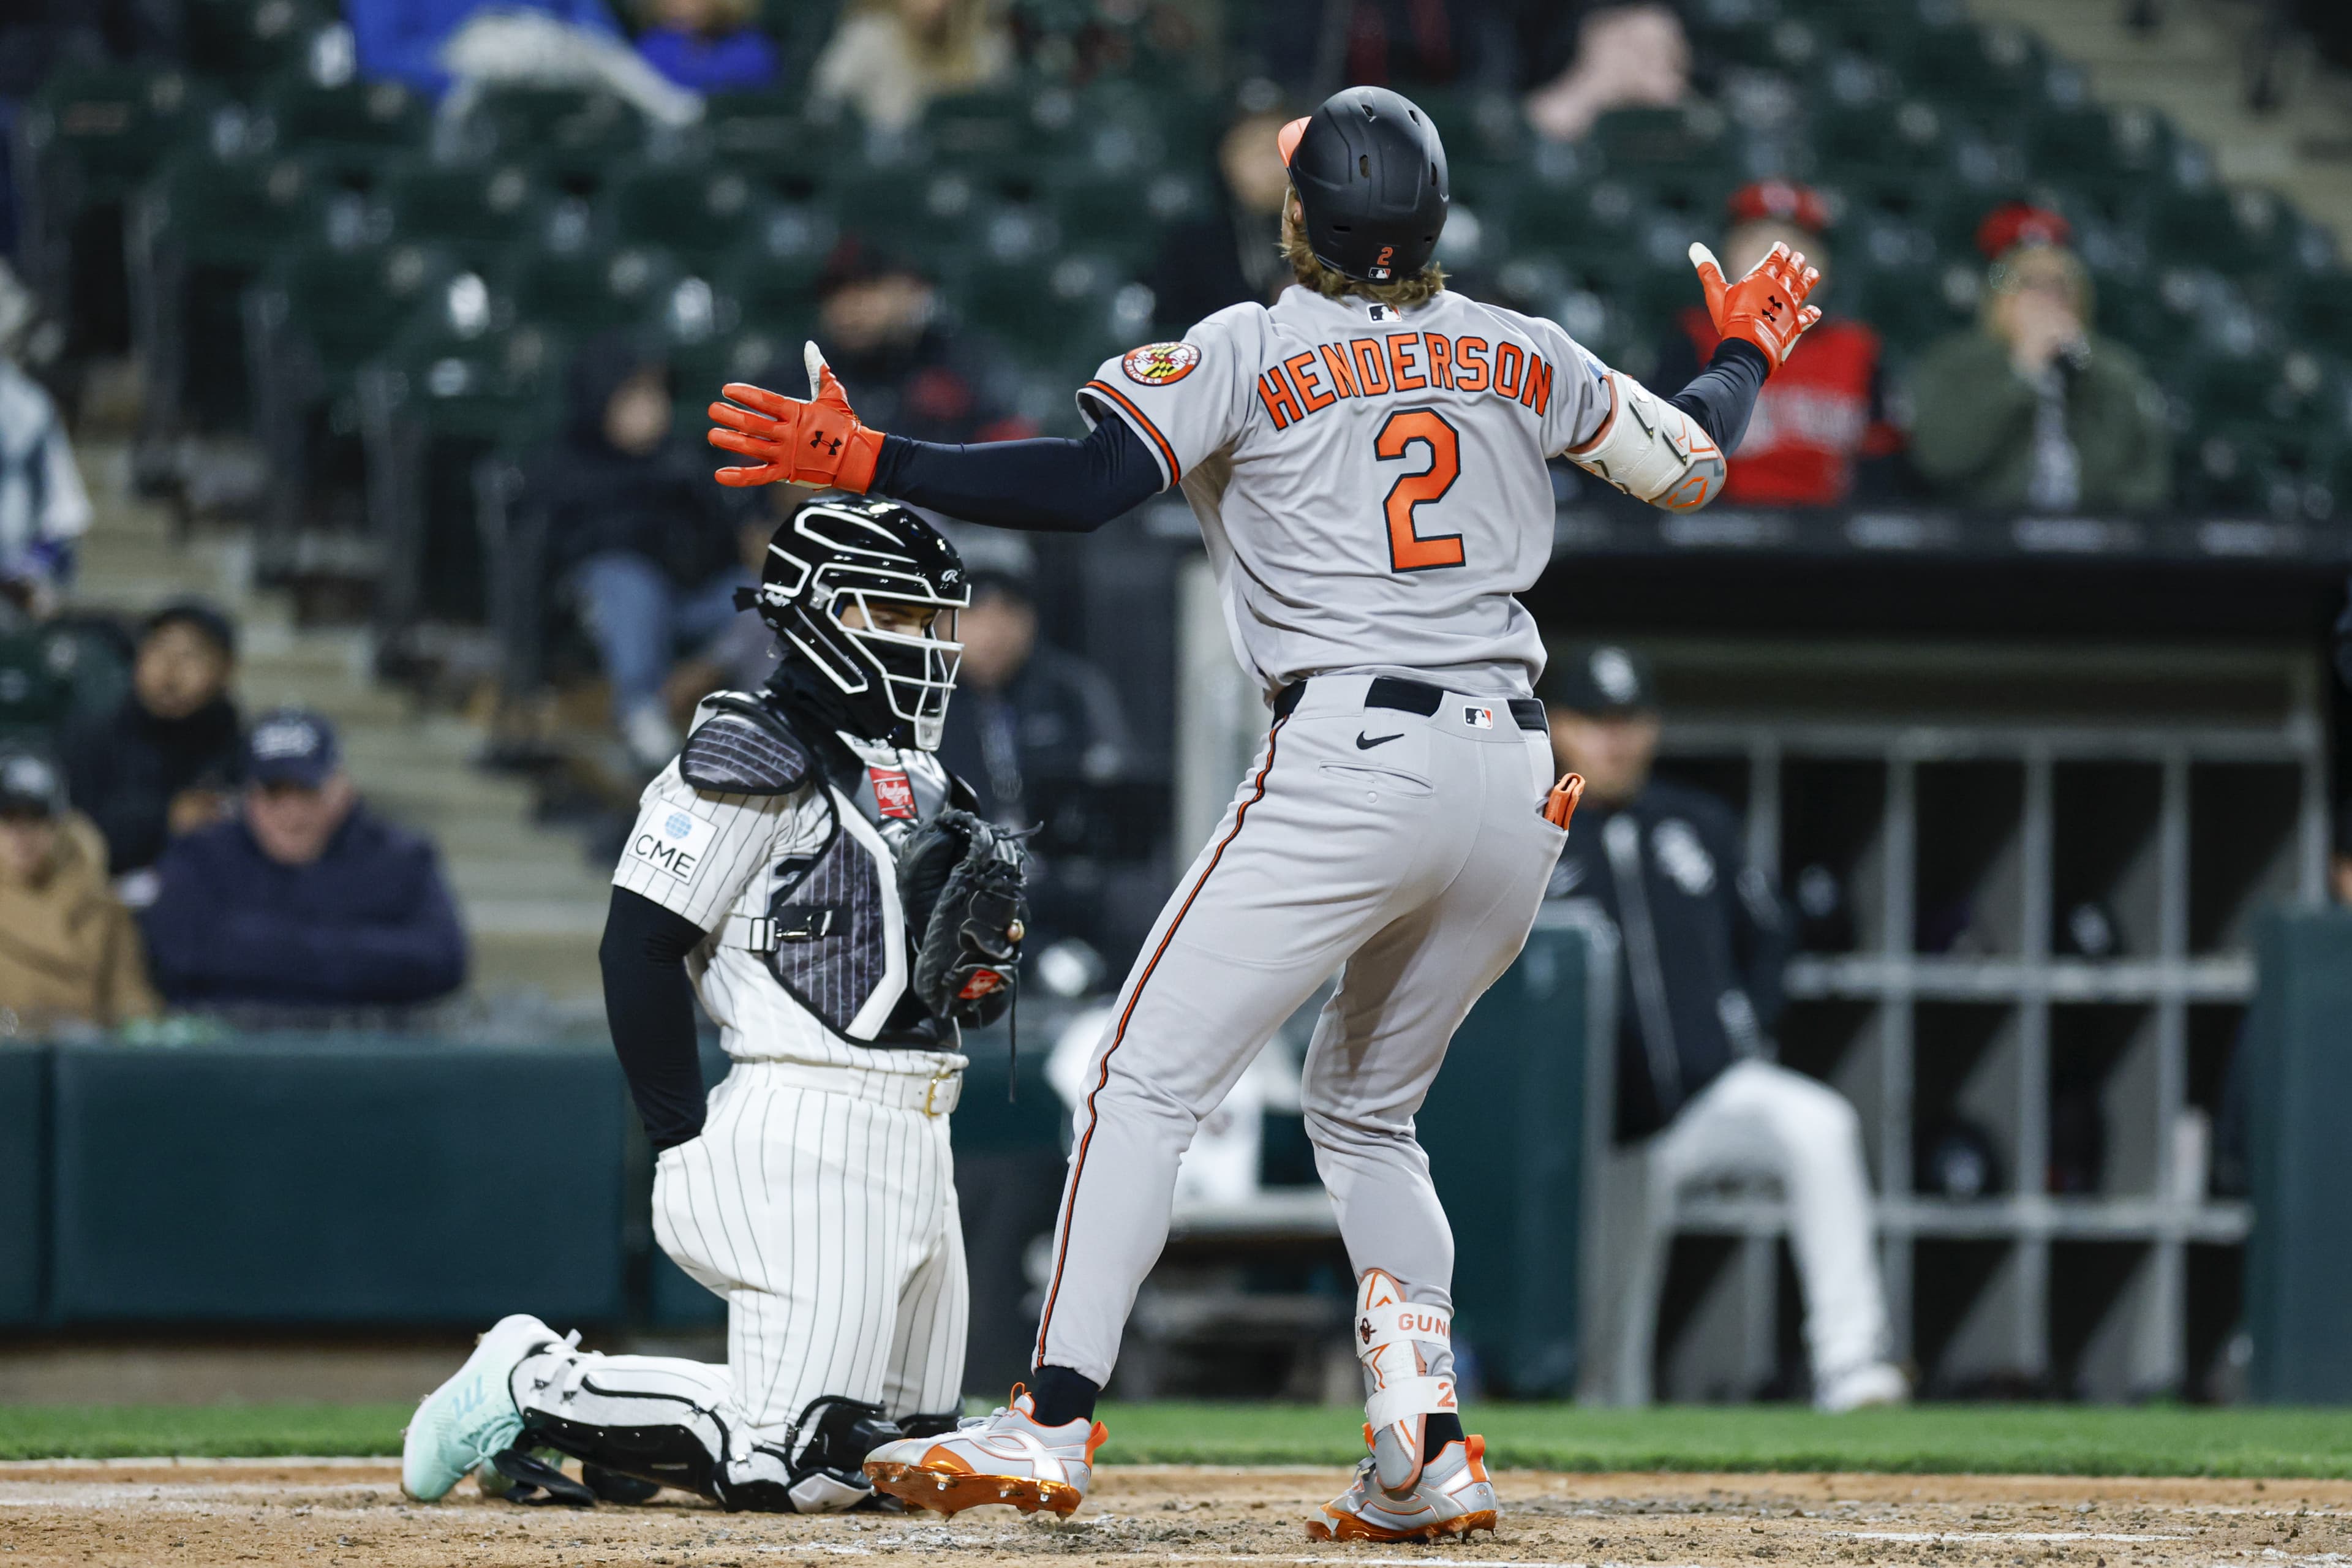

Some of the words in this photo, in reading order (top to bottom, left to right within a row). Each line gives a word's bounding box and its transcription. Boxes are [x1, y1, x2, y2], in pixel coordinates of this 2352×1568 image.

[1377, 246, 1393, 265] 2
[1125, 359, 1163, 384] ORIOLES
[1259, 332, 1553, 431] HENDERSON
[1374, 407, 1466, 573] 2
[636, 834, 696, 878] CME
[1437, 1382, 1455, 1408] 2
